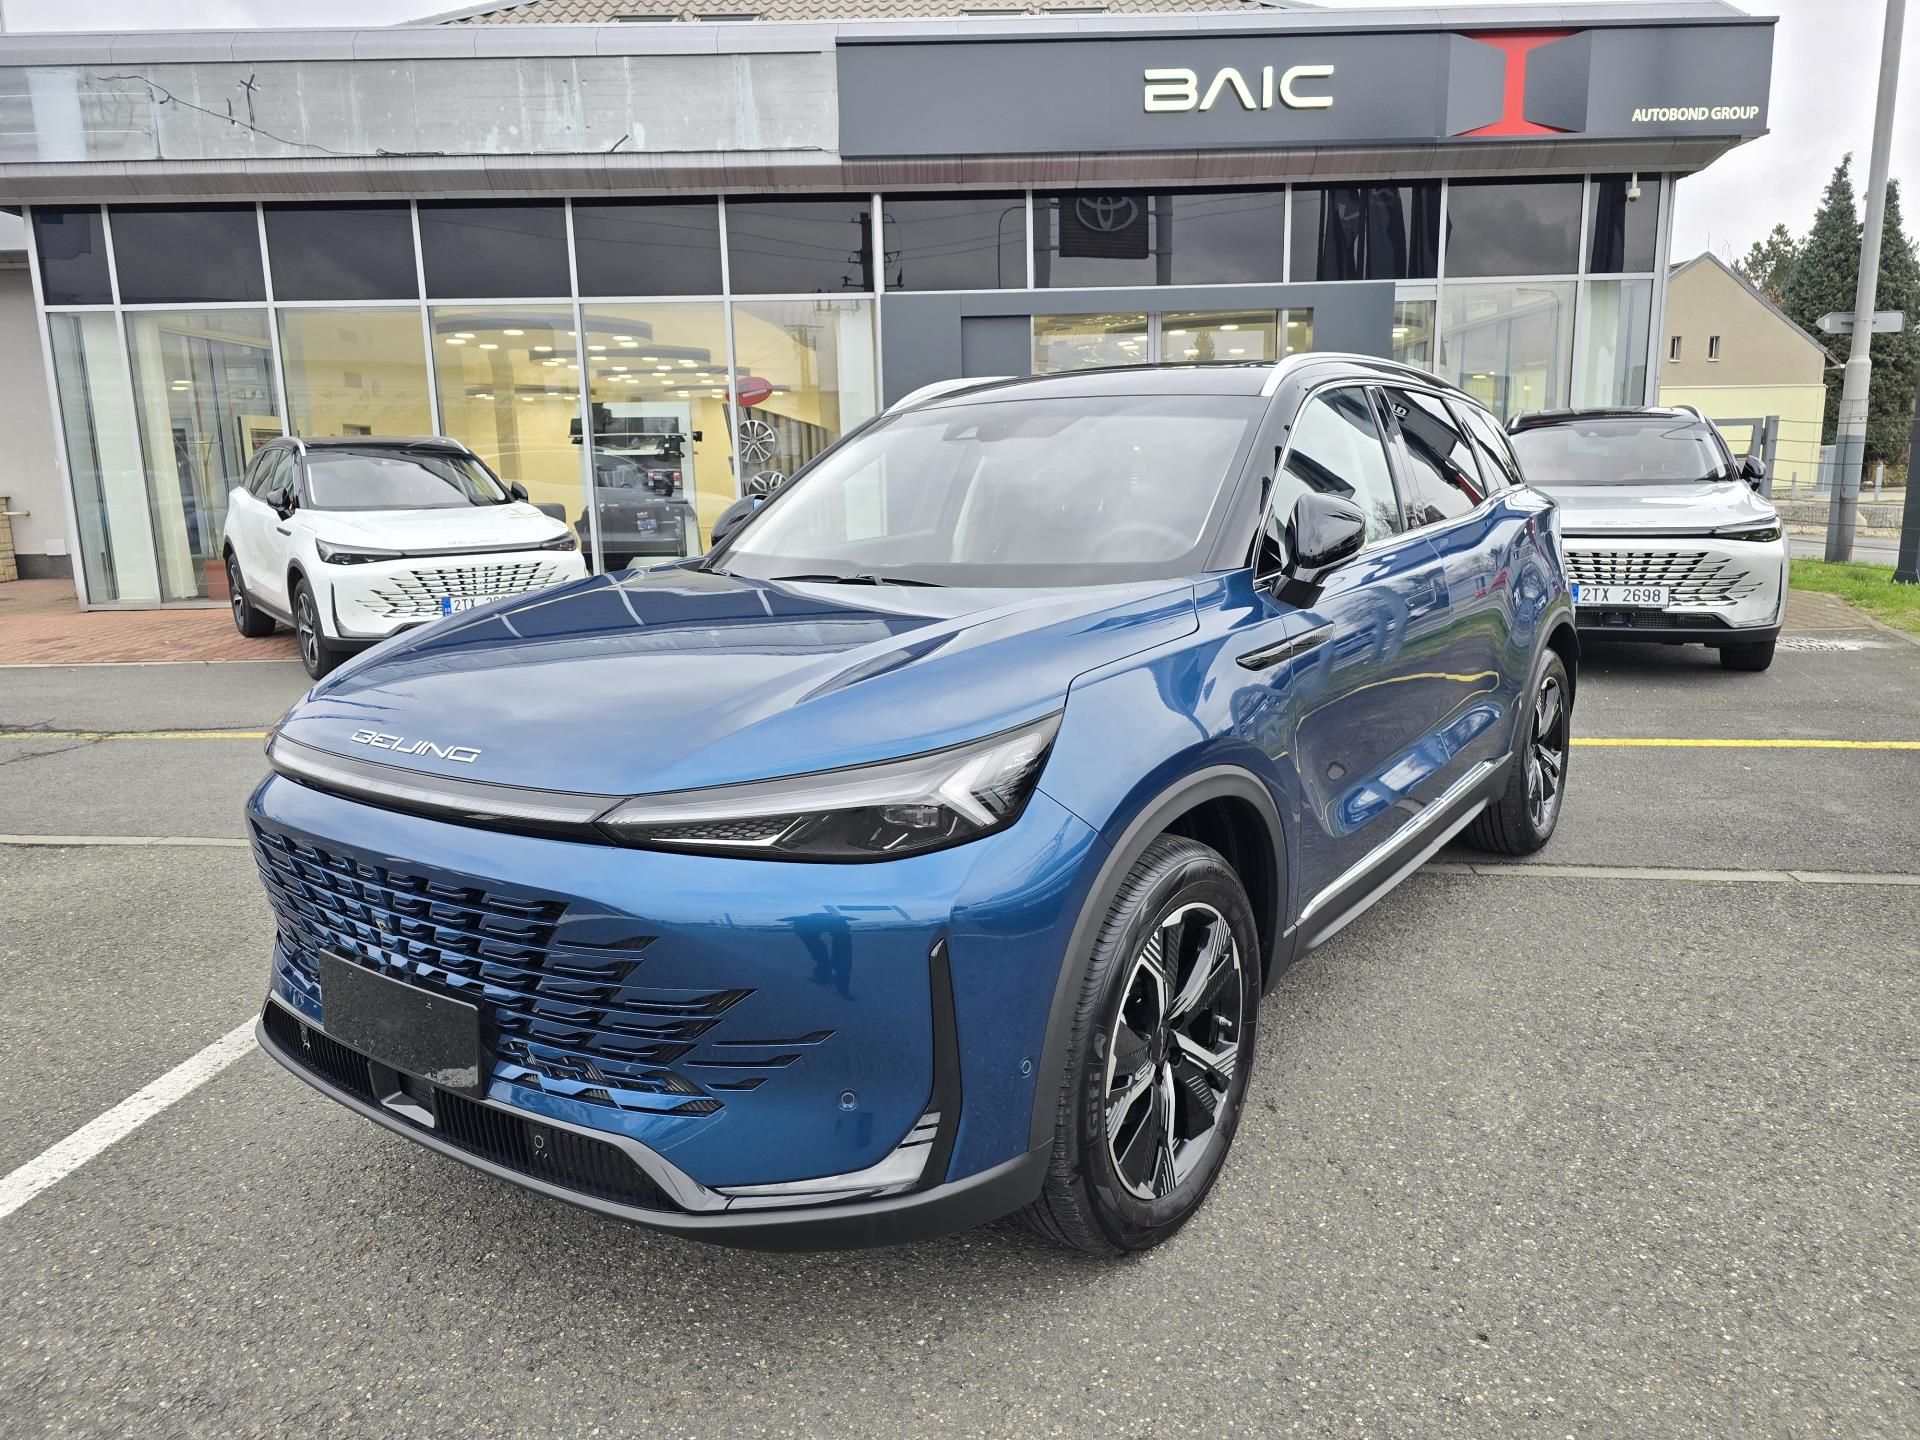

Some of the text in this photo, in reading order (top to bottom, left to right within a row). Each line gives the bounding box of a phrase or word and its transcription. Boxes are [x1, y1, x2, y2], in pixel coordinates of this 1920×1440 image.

[1144, 65, 1334, 112] BAIC
[1632, 105, 1759, 122] AUTOBOND GROUP
[1582, 587, 1661, 603] 2TX 2698
[454, 598, 476, 611] 2TX
[350, 729, 482, 763] BEIJING
